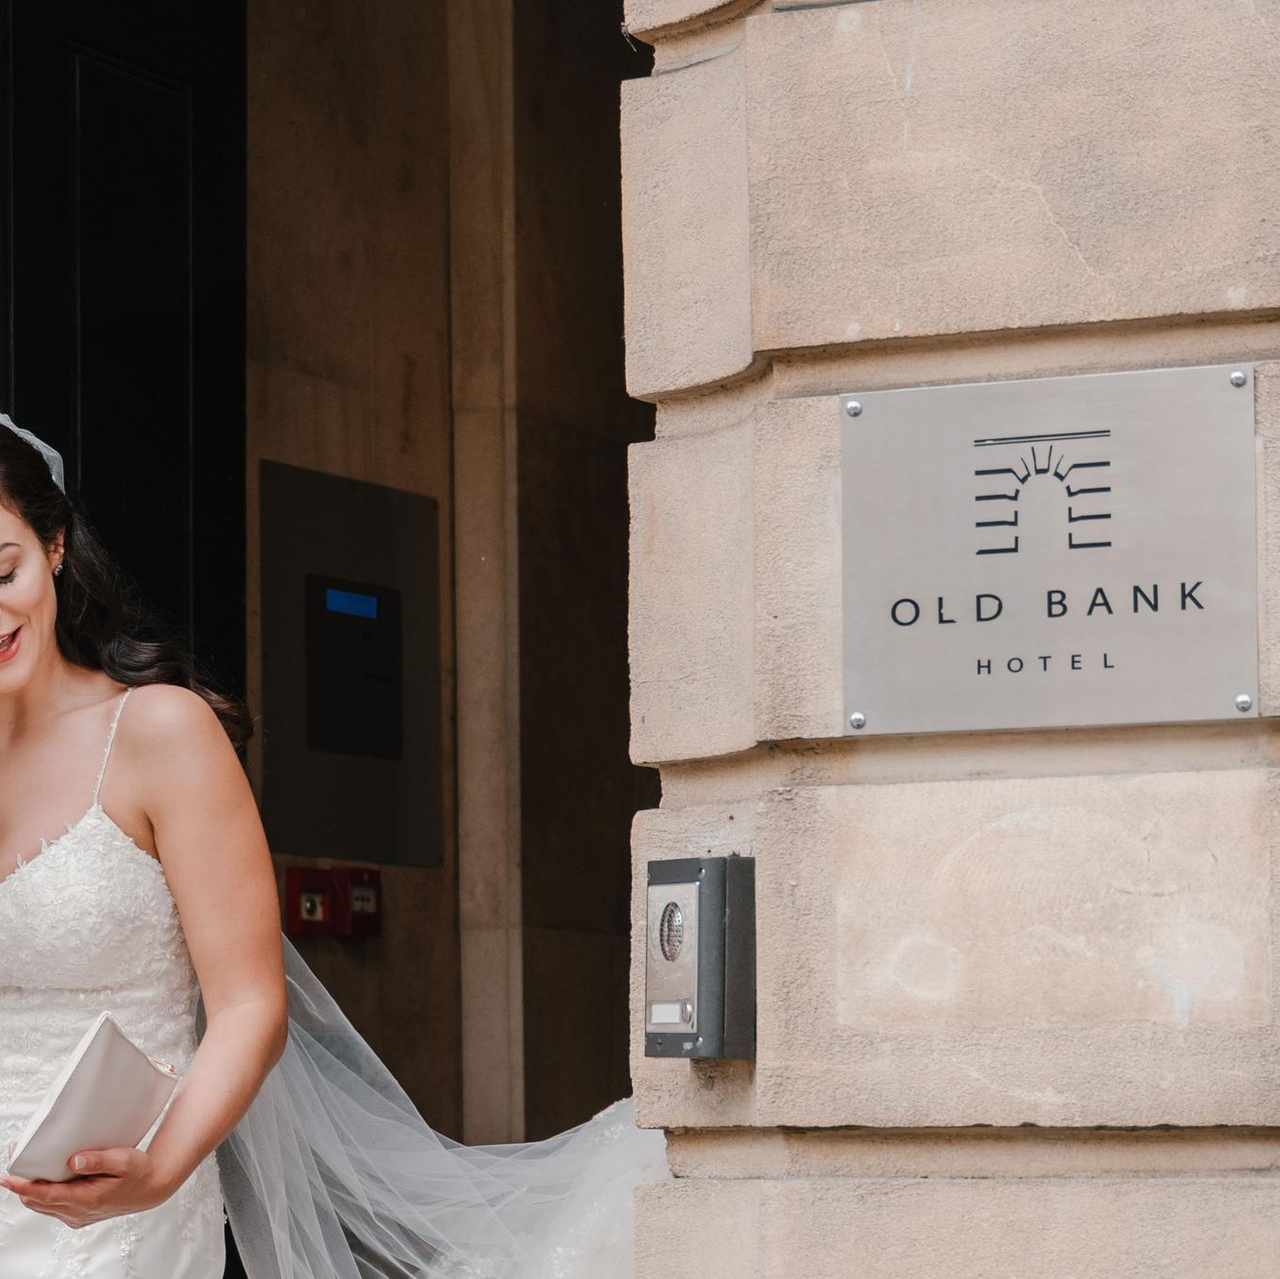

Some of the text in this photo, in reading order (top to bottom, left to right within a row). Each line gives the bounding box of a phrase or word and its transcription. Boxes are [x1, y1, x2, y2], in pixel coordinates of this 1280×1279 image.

[890, 581, 1205, 627] OLD BANK
[977, 652, 1115, 675] HOTEL
